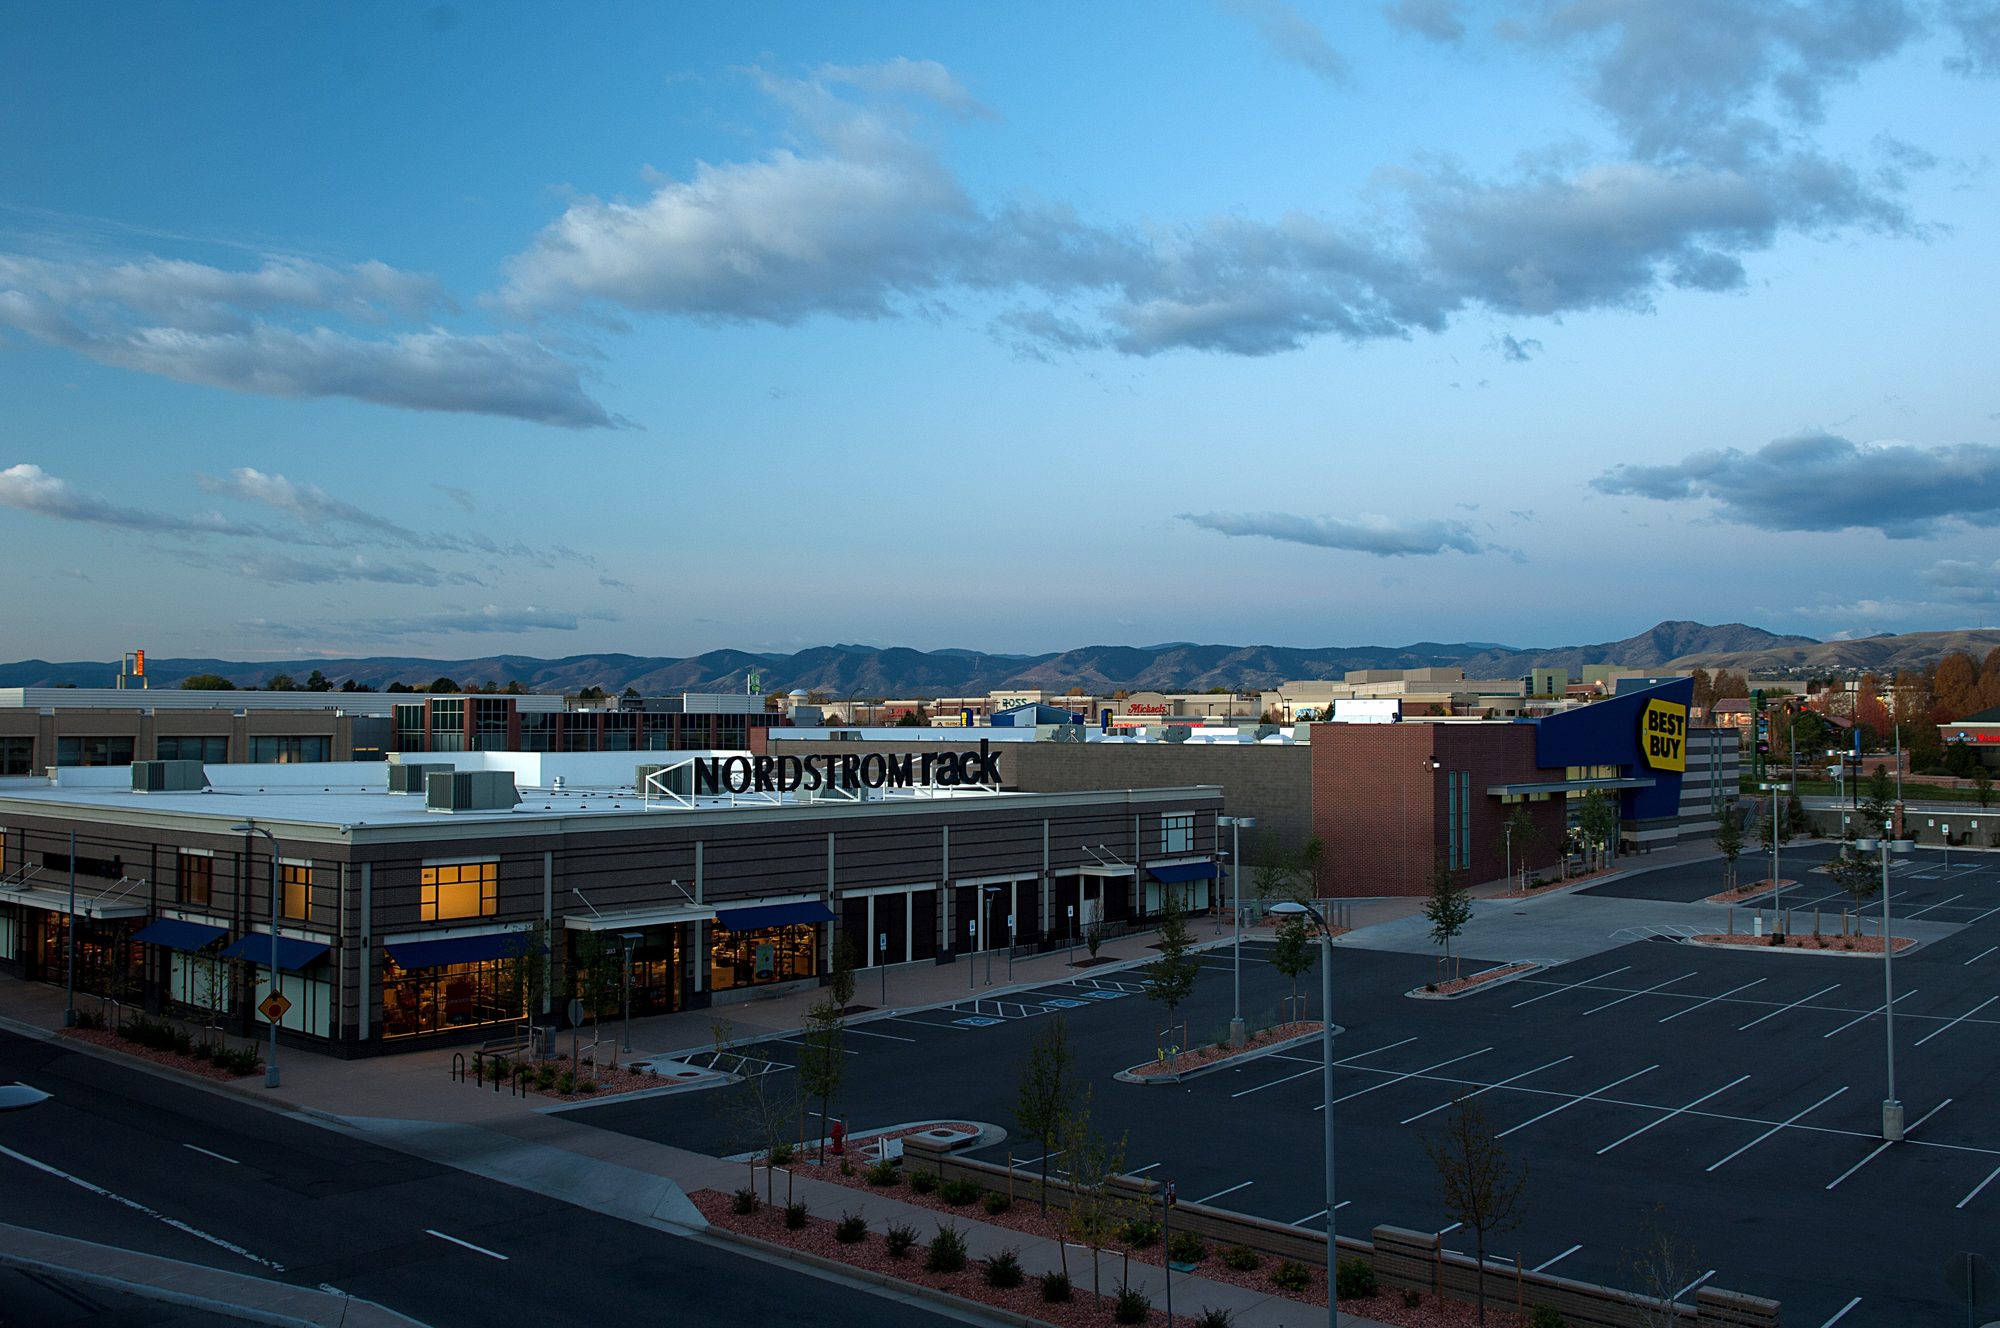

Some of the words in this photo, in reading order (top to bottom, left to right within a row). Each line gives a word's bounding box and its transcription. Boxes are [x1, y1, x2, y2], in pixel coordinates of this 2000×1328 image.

[1128, 703, 1168, 714] Michaels
[1648, 709, 1684, 736] BEST
[1650, 734, 1681, 760] BUY
[694, 752, 914, 795] NORDSTROM
[920, 738, 1003, 786] rack
